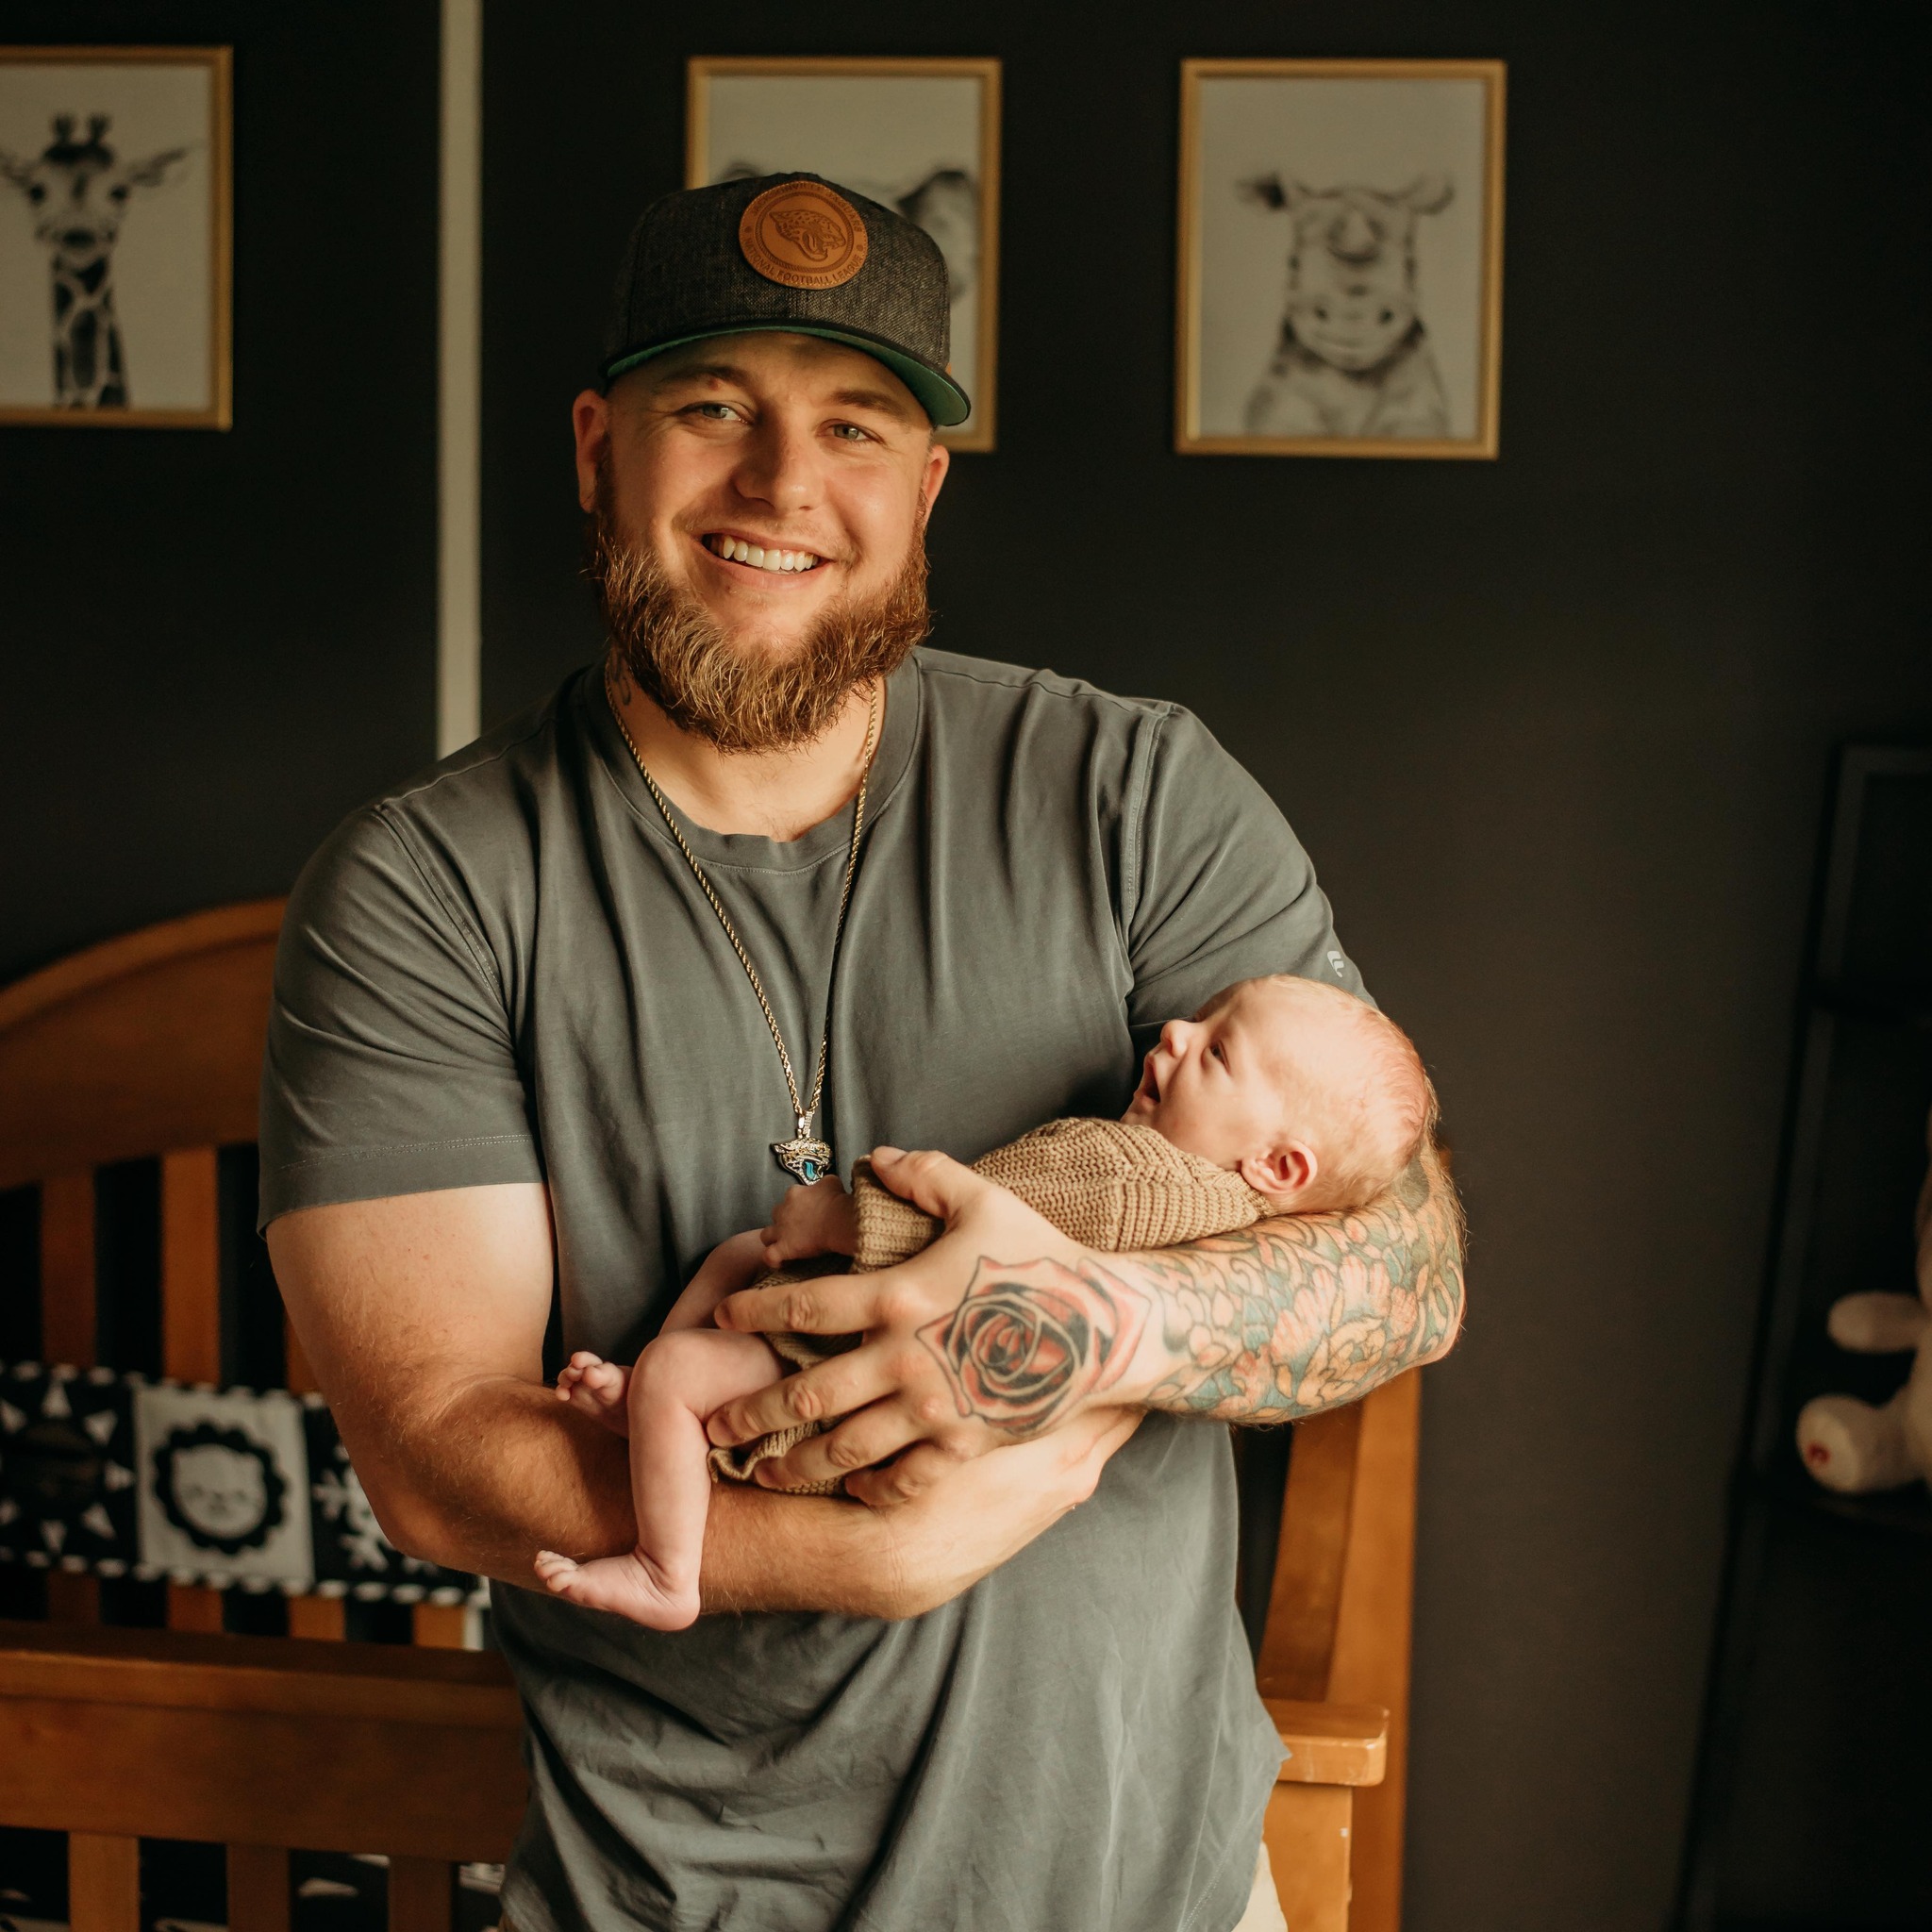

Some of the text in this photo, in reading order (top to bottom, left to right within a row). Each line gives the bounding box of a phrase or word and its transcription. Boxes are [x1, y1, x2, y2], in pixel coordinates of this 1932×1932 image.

[744, 238, 863, 283] NATIONAL FOOTBALL LEAGUE
